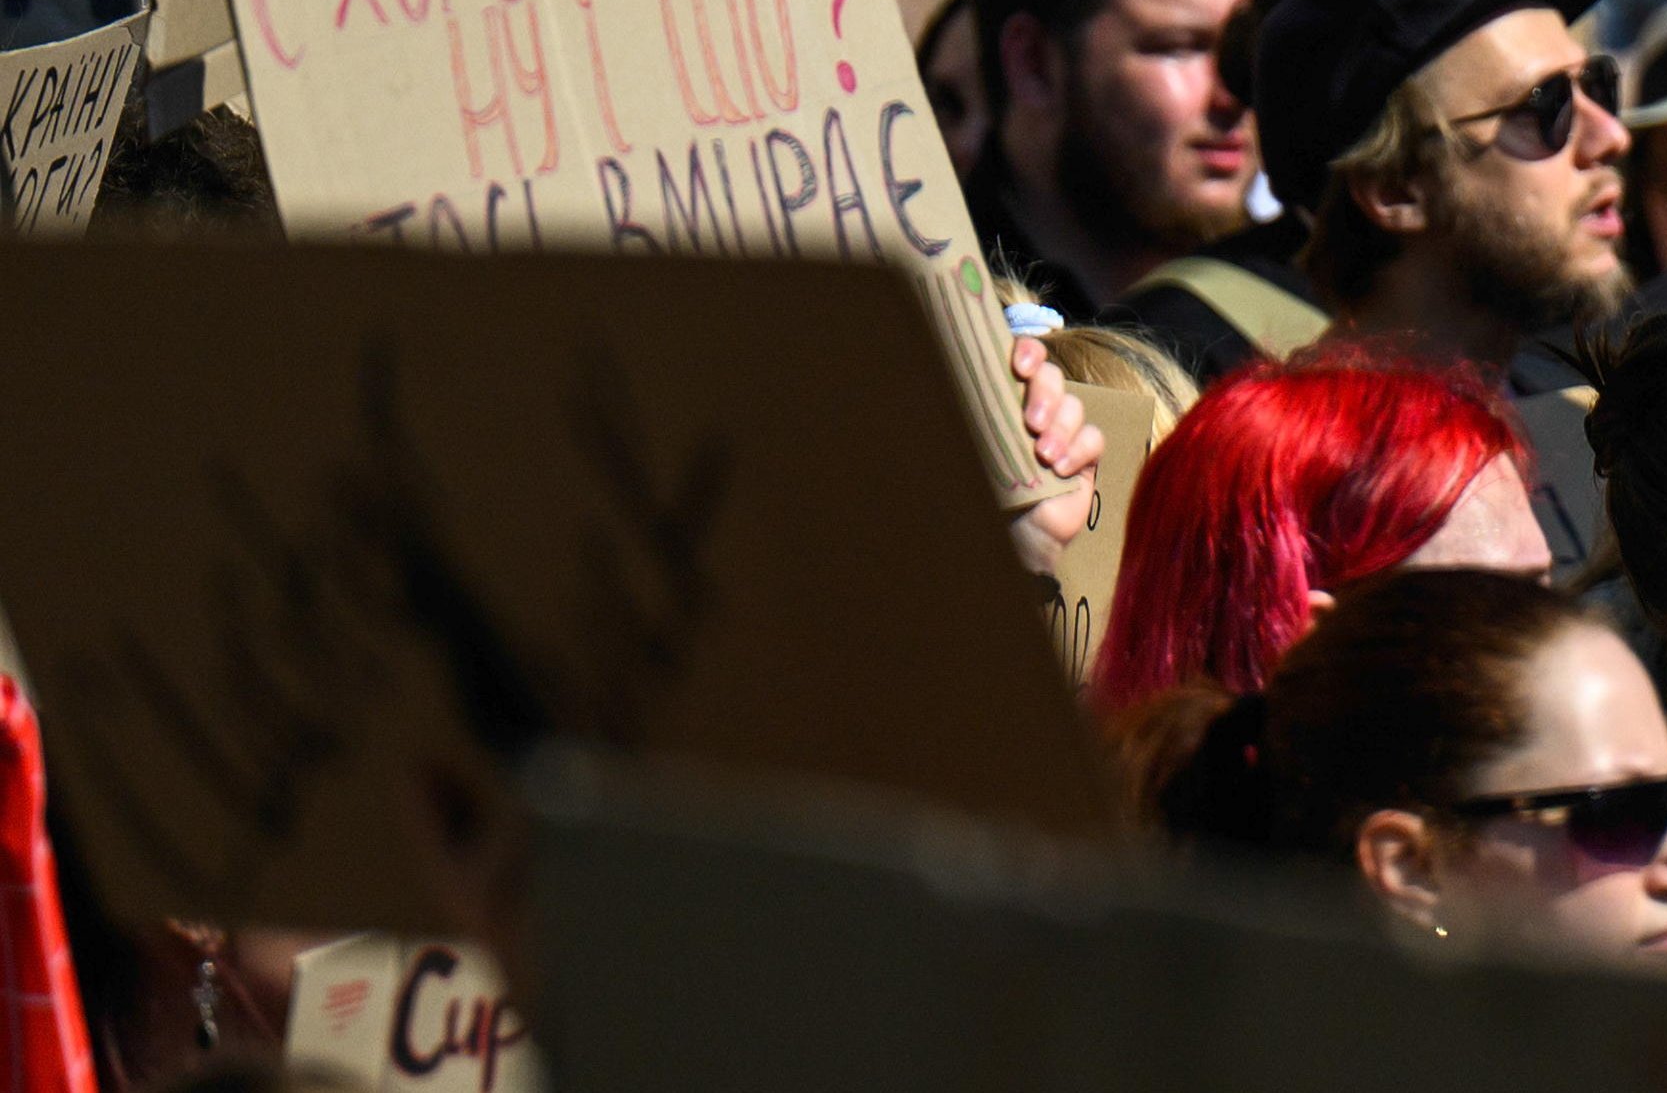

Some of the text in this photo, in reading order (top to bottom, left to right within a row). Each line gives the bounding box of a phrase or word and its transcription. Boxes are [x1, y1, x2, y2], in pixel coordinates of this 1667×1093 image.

[0, 41, 134, 163] КРАЇНУ
[445, 0, 562, 181] НУ
[8, 137, 104, 235] ОГИ?
